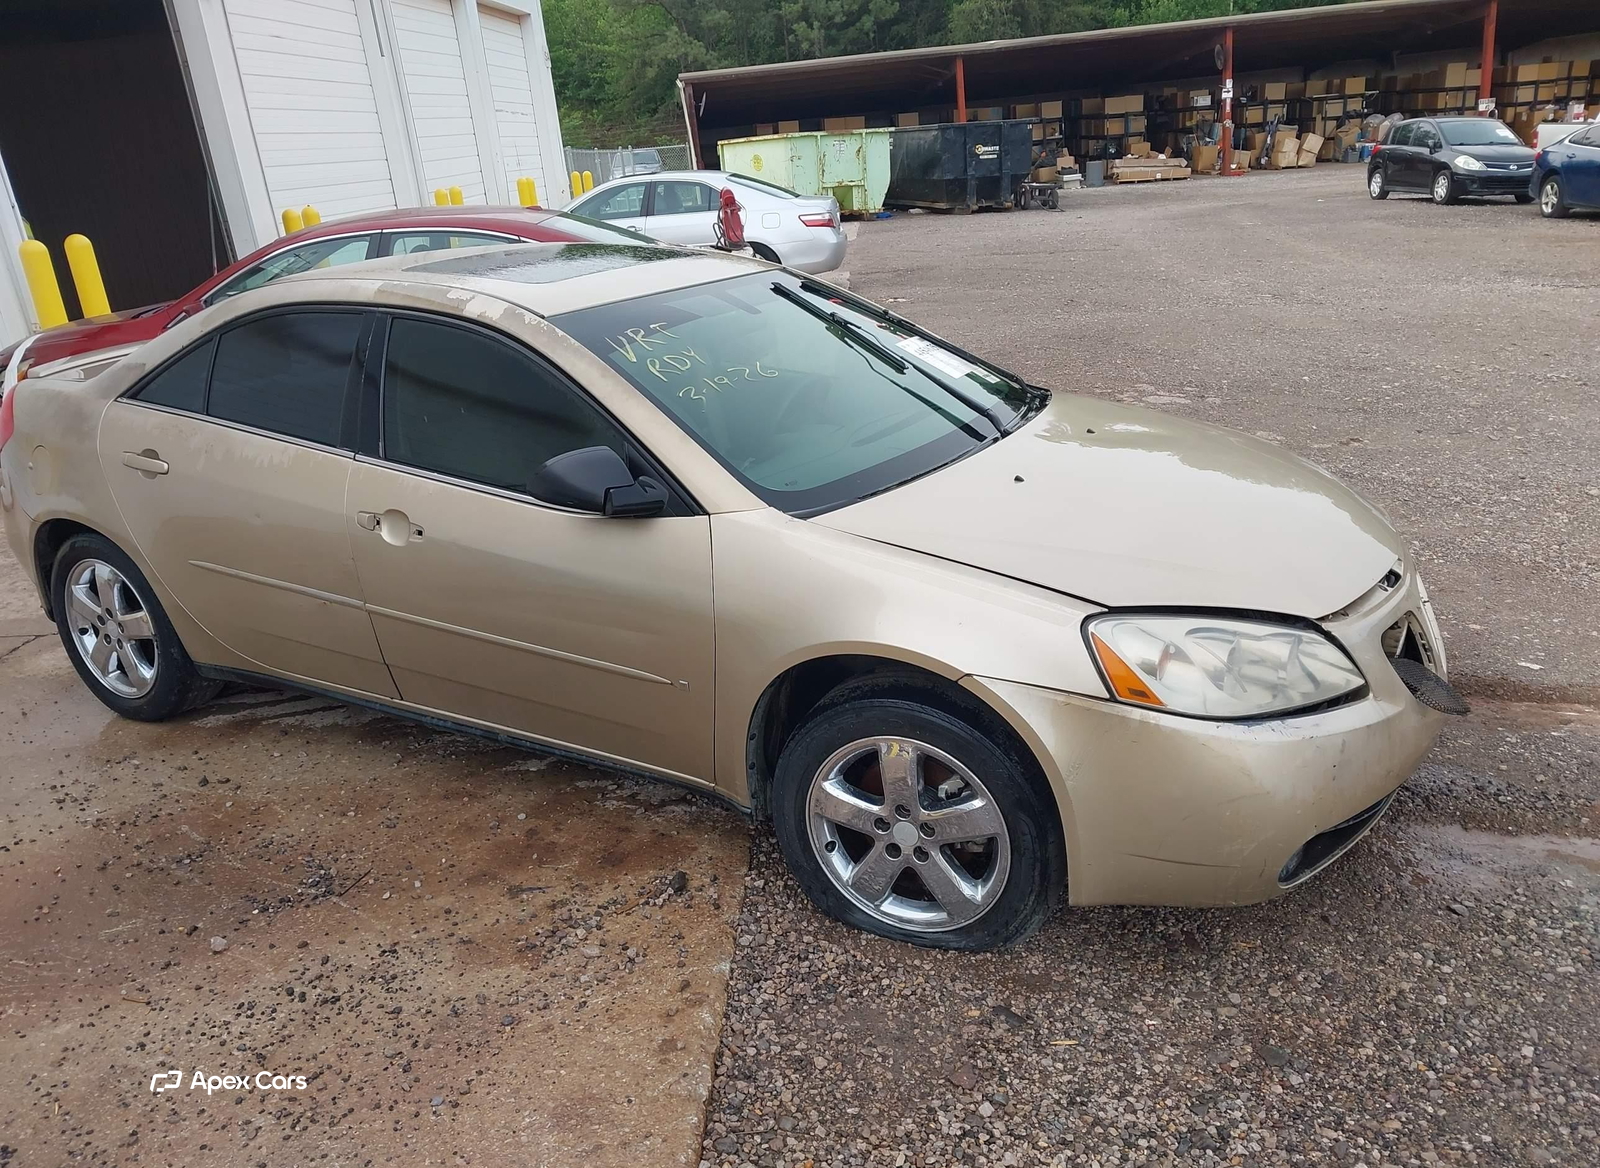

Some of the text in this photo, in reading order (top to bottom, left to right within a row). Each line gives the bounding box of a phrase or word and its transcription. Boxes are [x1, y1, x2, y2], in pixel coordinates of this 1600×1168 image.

[605, 322, 680, 362] VRT
[646, 346, 706, 382] RDY
[677, 361, 779, 412] 3-19-26
